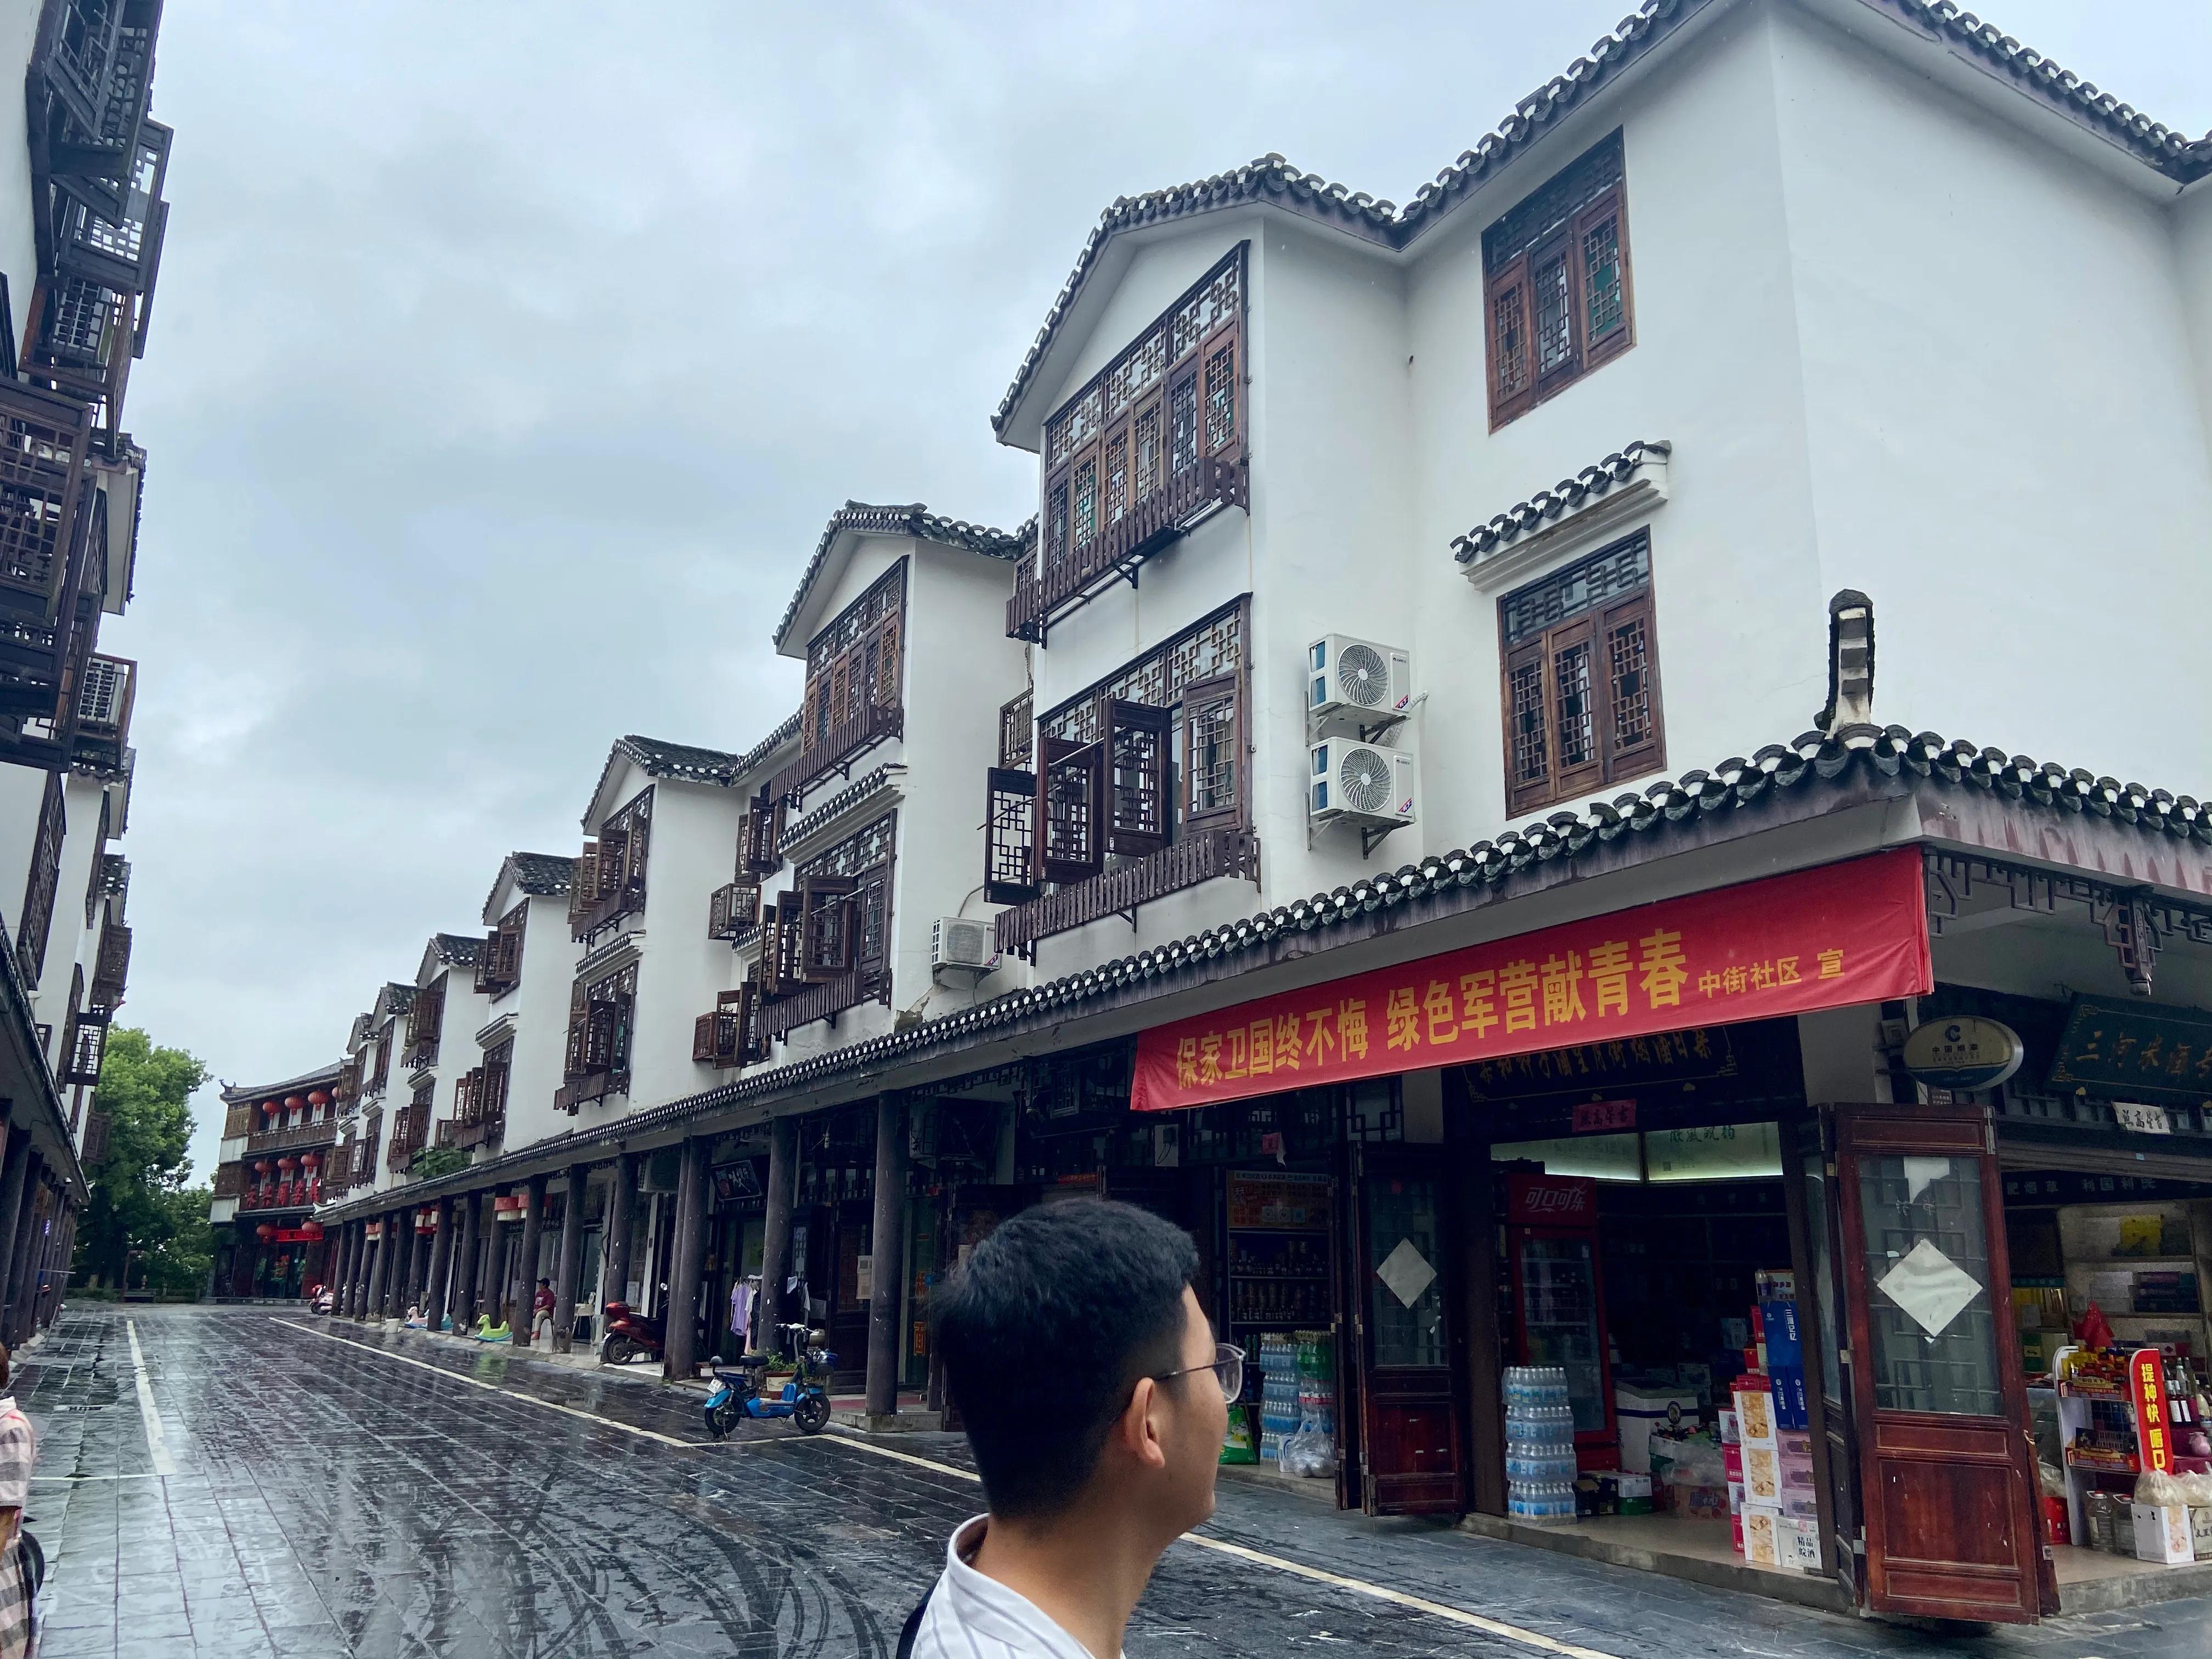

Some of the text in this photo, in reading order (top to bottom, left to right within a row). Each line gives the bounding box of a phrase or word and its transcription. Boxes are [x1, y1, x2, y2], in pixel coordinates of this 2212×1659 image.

[1177, 929, 1845, 1090] 保家卫国终不悔 绿色军营献青春 中街社区 宣
[1932, 1043, 1979, 1054] 中国烟草
[1797, 1536, 1813, 1548] 精品
